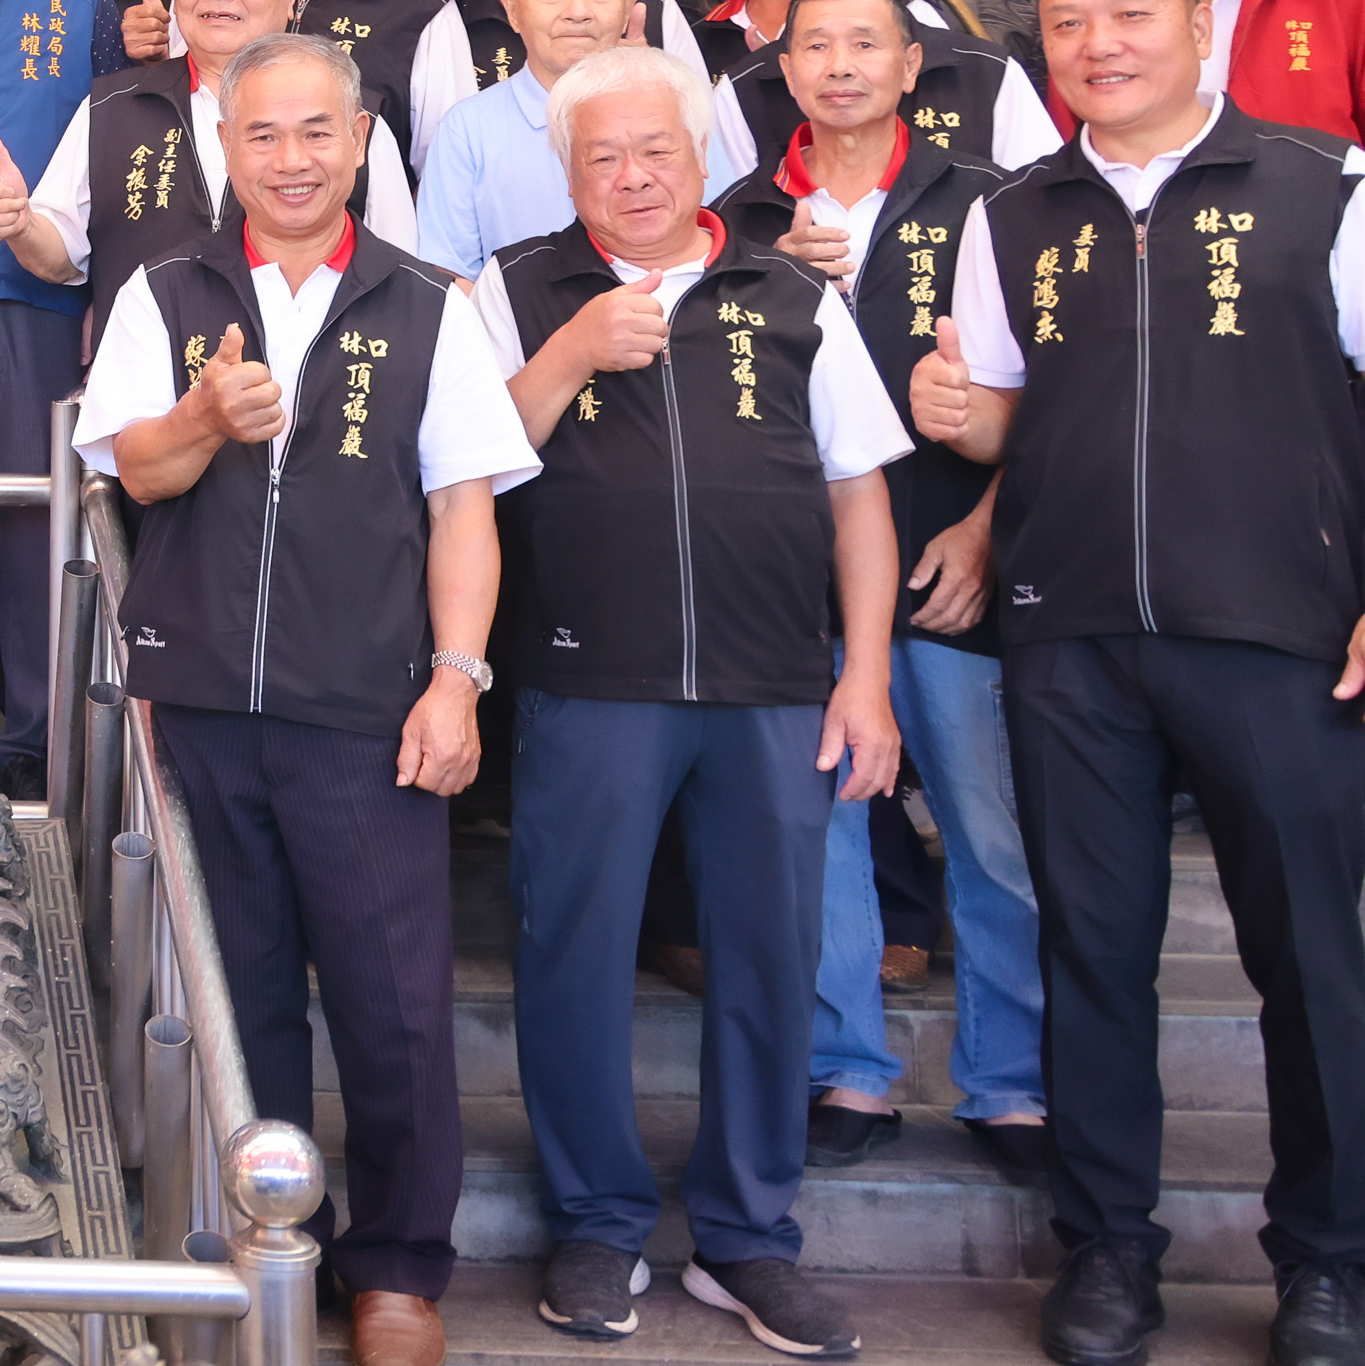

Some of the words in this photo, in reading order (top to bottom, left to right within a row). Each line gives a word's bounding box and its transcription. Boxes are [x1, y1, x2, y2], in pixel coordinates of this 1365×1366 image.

[330, 16, 371, 38] 林口
[19, 12, 44, 81] 林耀長
[913, 107, 961, 128] 林口
[897, 221, 948, 244] 林口
[1193, 207, 1255, 234] 林口
[1072, 223, 1098, 273] 委員
[717, 301, 766, 326] 林口
[339, 331, 389, 357] 林口
